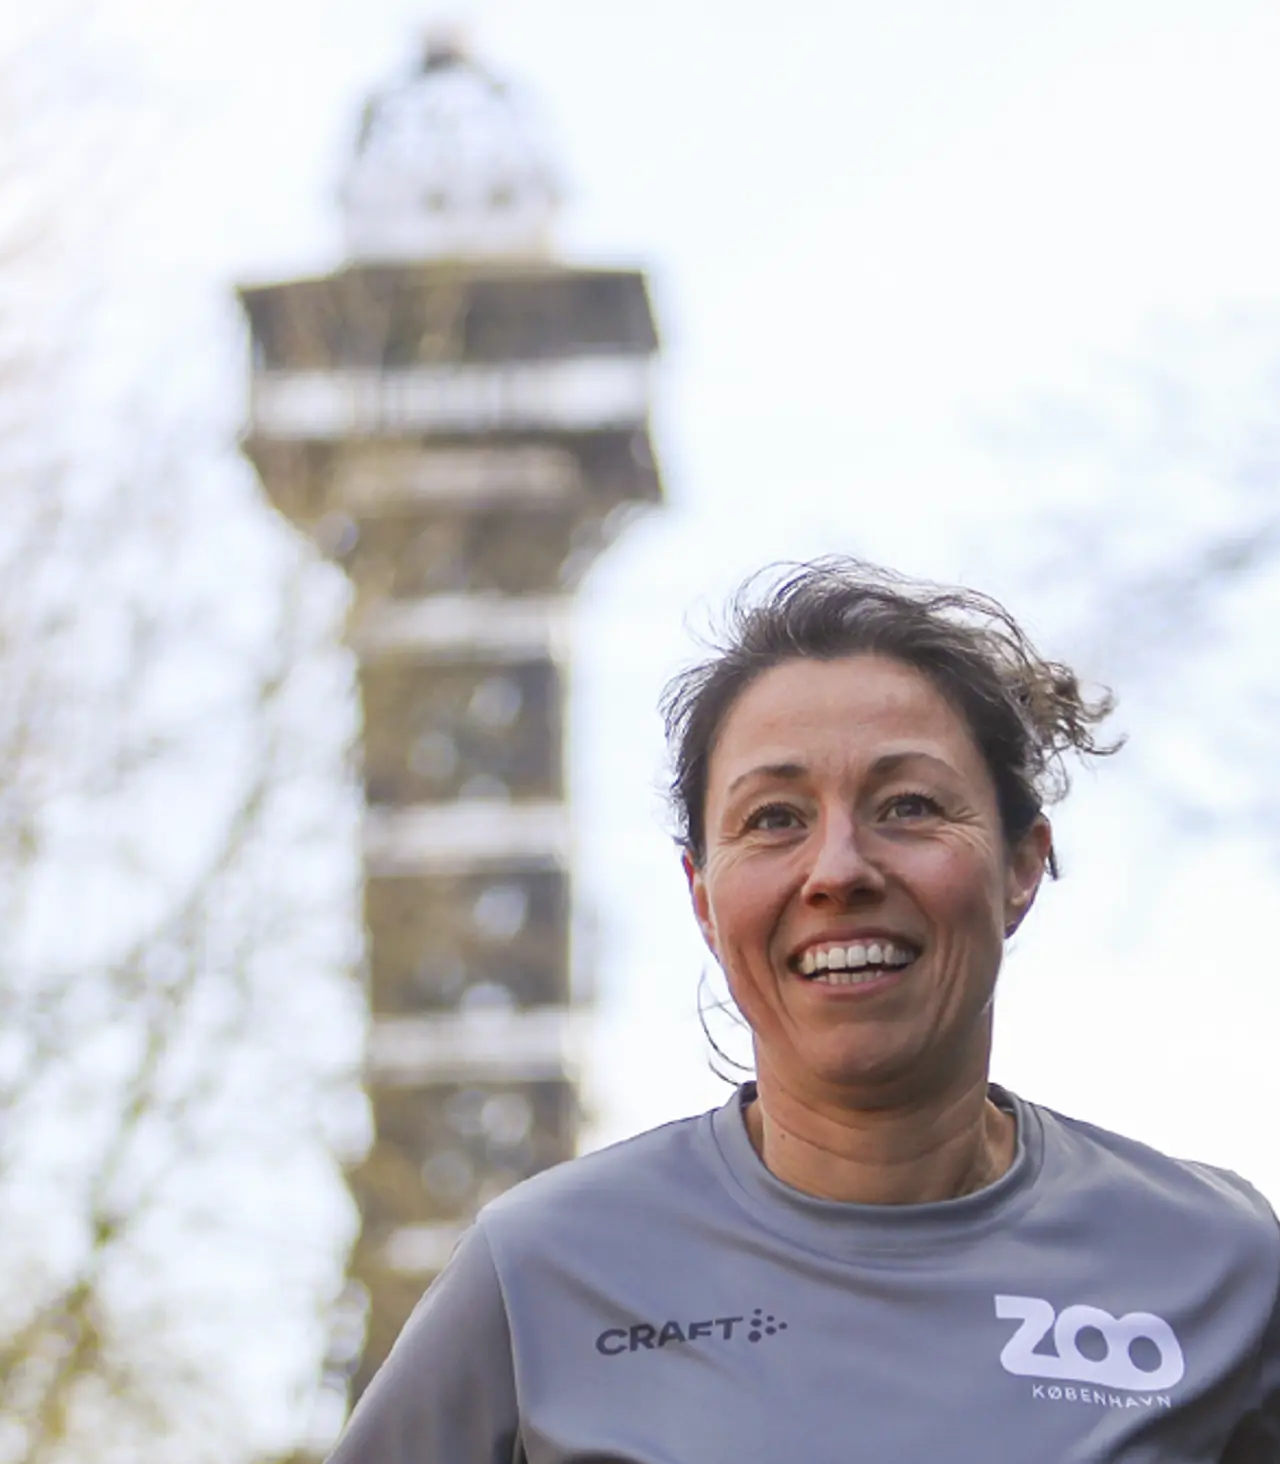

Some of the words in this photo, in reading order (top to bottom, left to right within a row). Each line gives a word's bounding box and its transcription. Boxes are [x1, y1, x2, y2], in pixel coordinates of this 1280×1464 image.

[596, 1316, 743, 1356] CRAFT
[994, 1294, 1185, 1391] ZOO
[1032, 1384, 1172, 1408] KØBENHAVN
